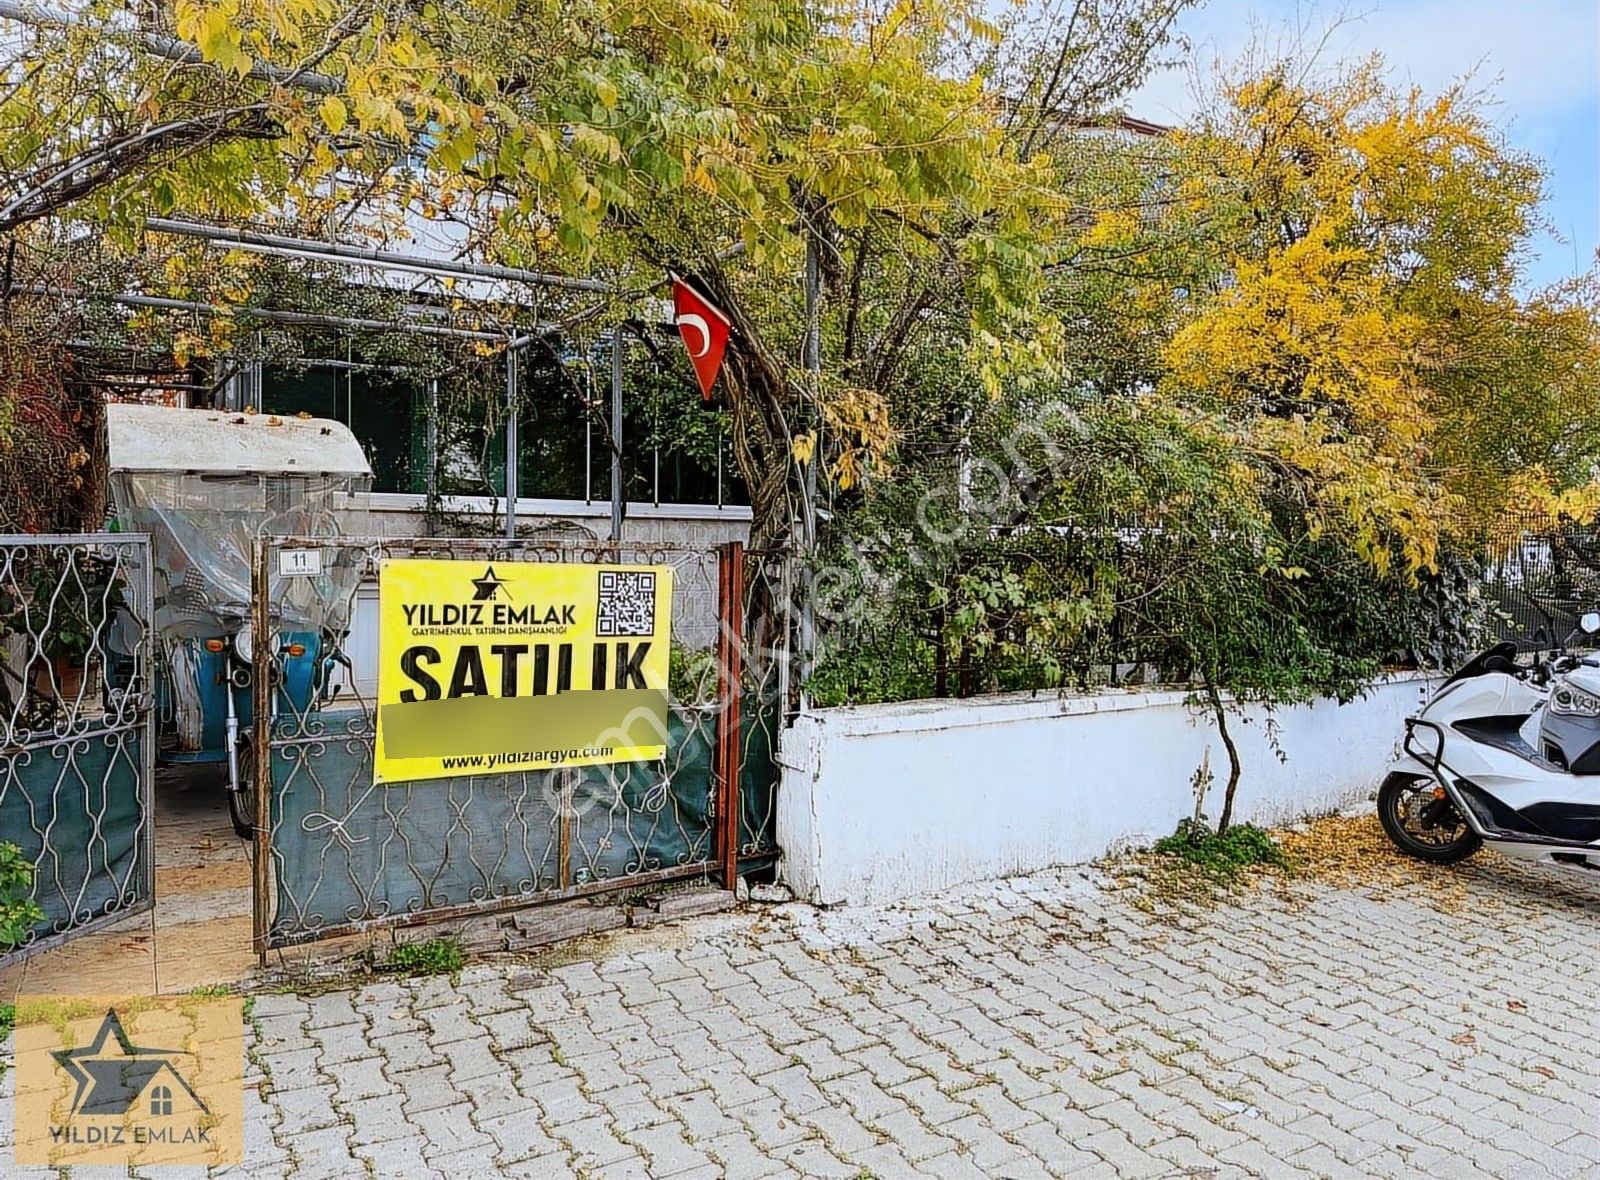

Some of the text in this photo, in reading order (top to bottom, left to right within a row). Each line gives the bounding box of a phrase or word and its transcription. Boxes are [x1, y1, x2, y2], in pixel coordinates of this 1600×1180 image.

[292, 553, 306, 567] 11
[402, 604, 576, 626] YILDIZ EMLAK
[475, 626, 507, 636] YATIRIM
